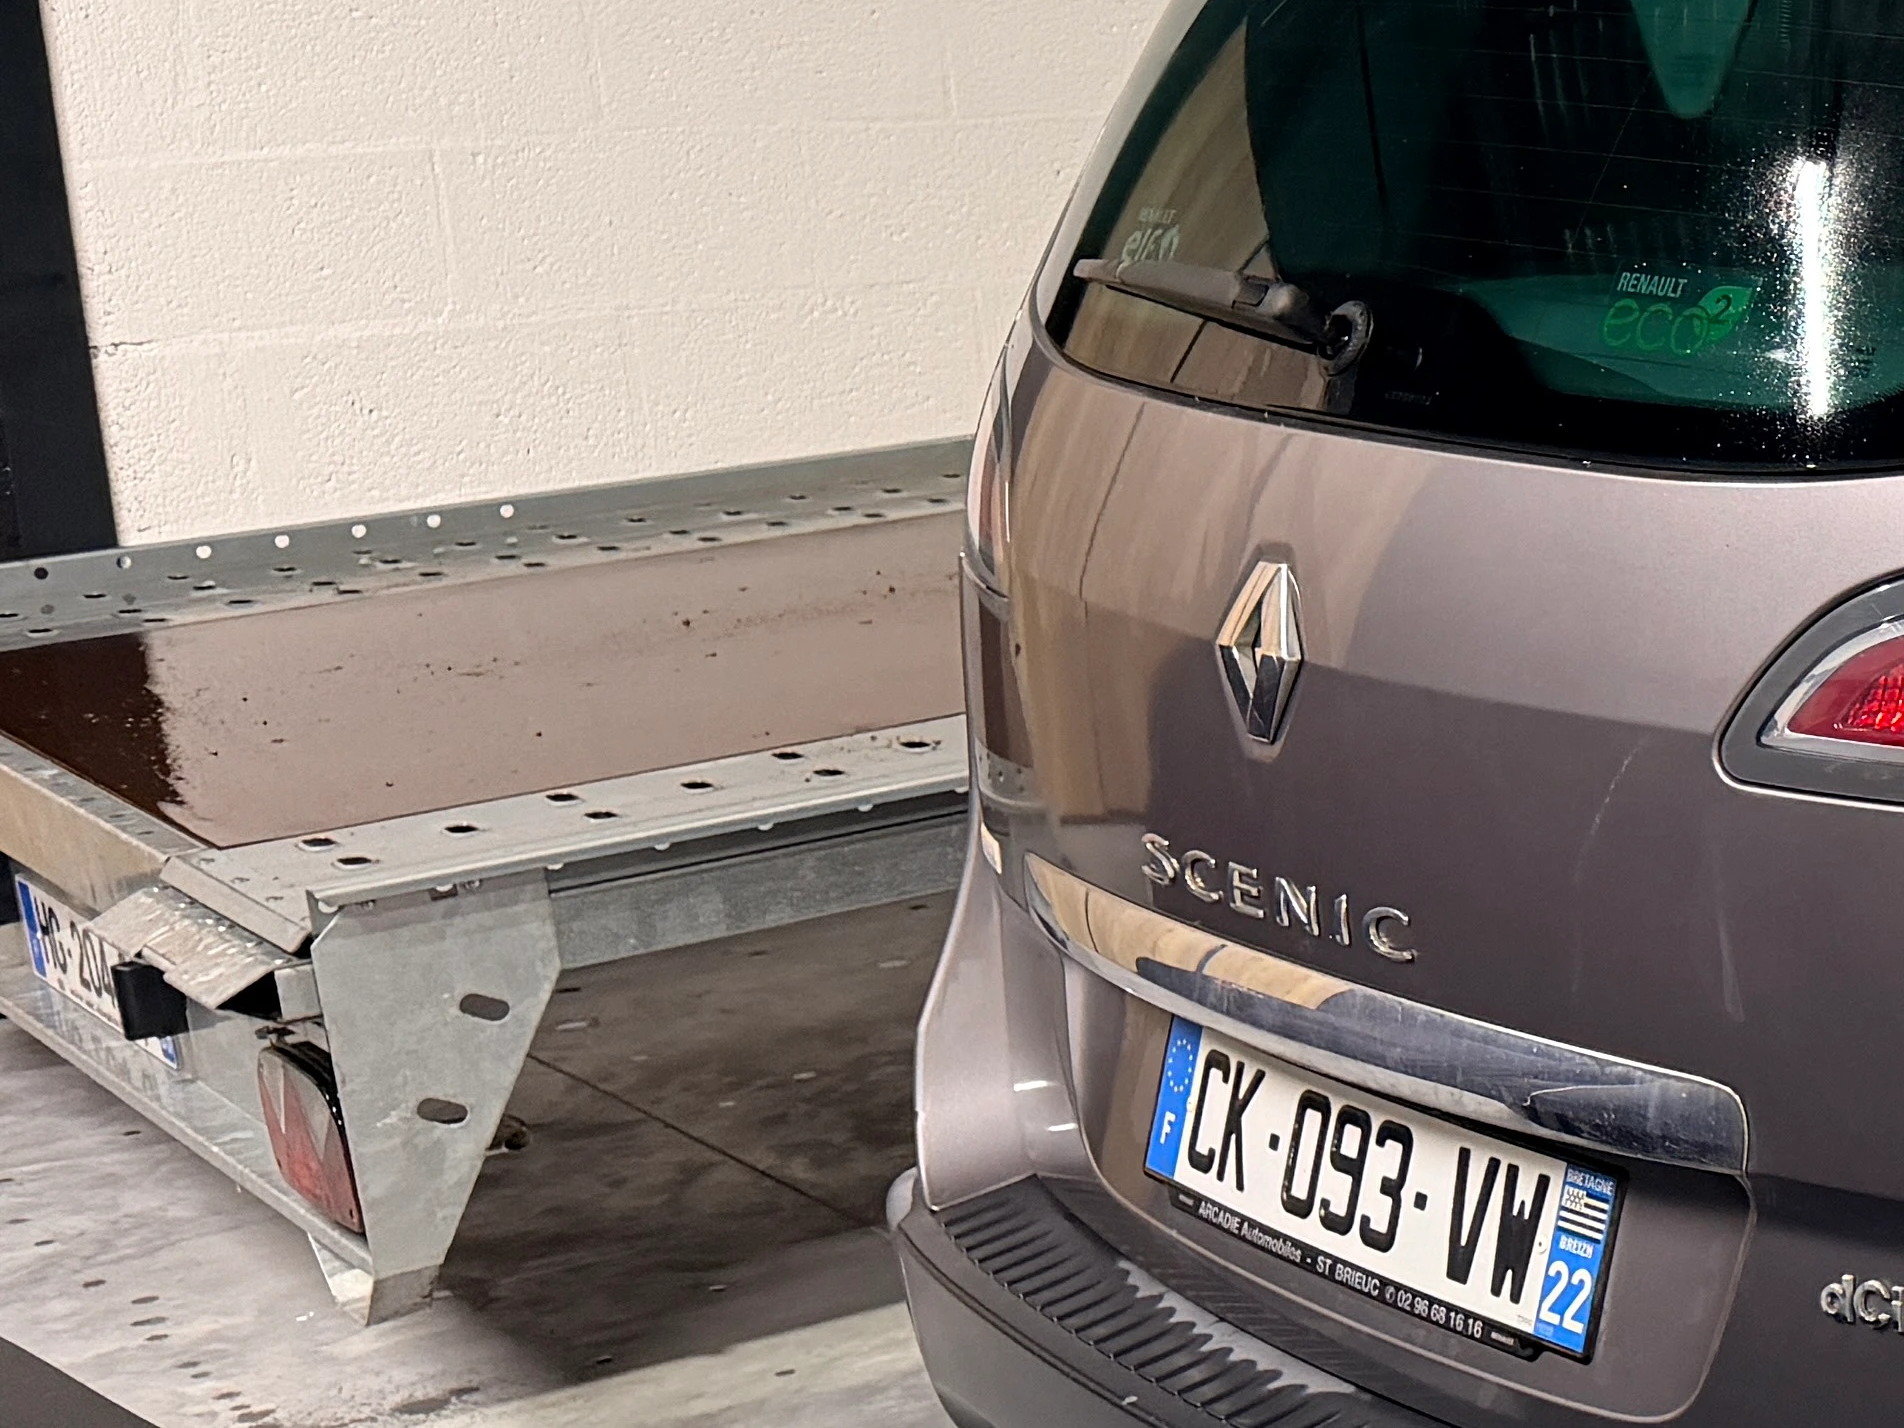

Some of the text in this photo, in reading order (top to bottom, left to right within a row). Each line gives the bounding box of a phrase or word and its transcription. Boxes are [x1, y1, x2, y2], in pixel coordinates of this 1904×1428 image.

[1617, 272, 1687, 298] RENAULT
[1141, 833, 1417, 962] SCENIC
[1160, 1111, 1176, 1145] F
[1567, 1169, 1615, 1196] BRETAGNE
[1199, 1201, 1240, 1234] ARCADIE
[1241, 1222, 1302, 1262] Automobiles
[1316, 1256, 1332, 1275] ST
[1335, 1263, 1380, 1296] BRIEUC
[1559, 1235, 1594, 1259] BREIZH
[1539, 1260, 1593, 1335] 22
